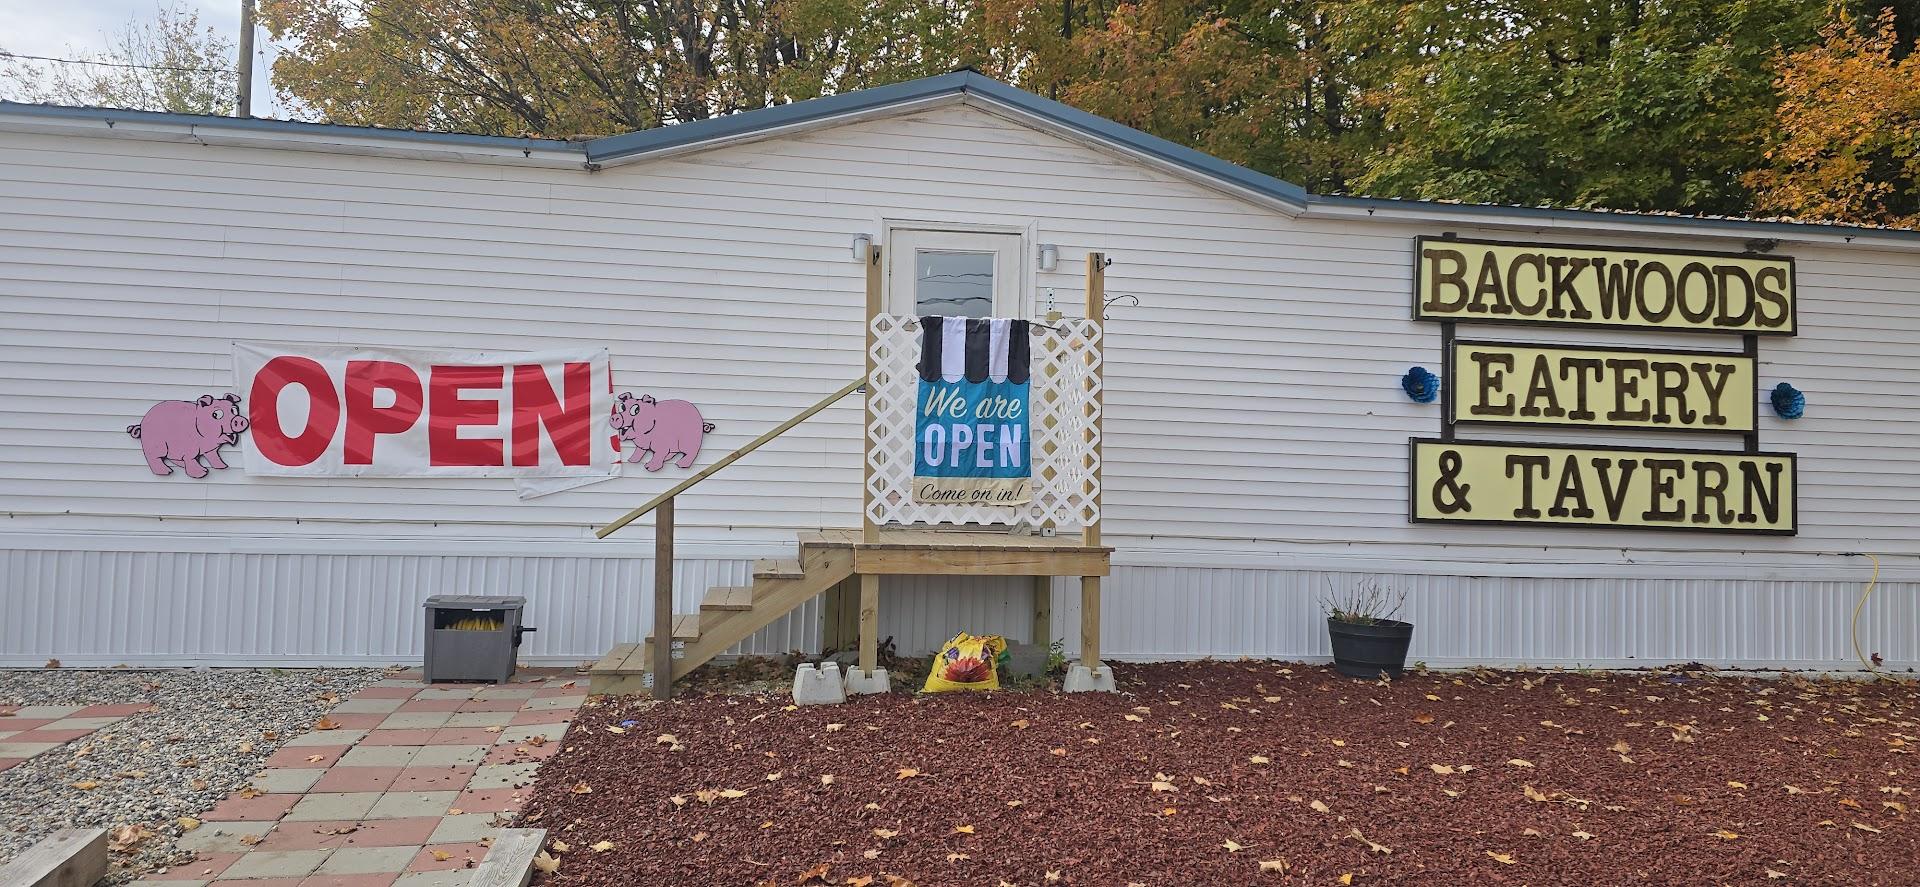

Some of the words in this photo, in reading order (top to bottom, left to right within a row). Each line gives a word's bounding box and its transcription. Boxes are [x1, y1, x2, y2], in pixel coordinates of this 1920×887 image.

[1422, 248, 1789, 328] BACKWOODS
[249, 355, 591, 467] OPEN
[924, 386, 968, 419] We
[976, 395, 1023, 419] are
[1470, 351, 1736, 426] EATERY
[924, 423, 1022, 468] OPEN
[919, 483, 967, 501] Come
[971, 488, 994, 501] on
[997, 484, 1024, 501] in!
[1432, 449, 1472, 515] &
[1505, 454, 1783, 525] TAVERN
